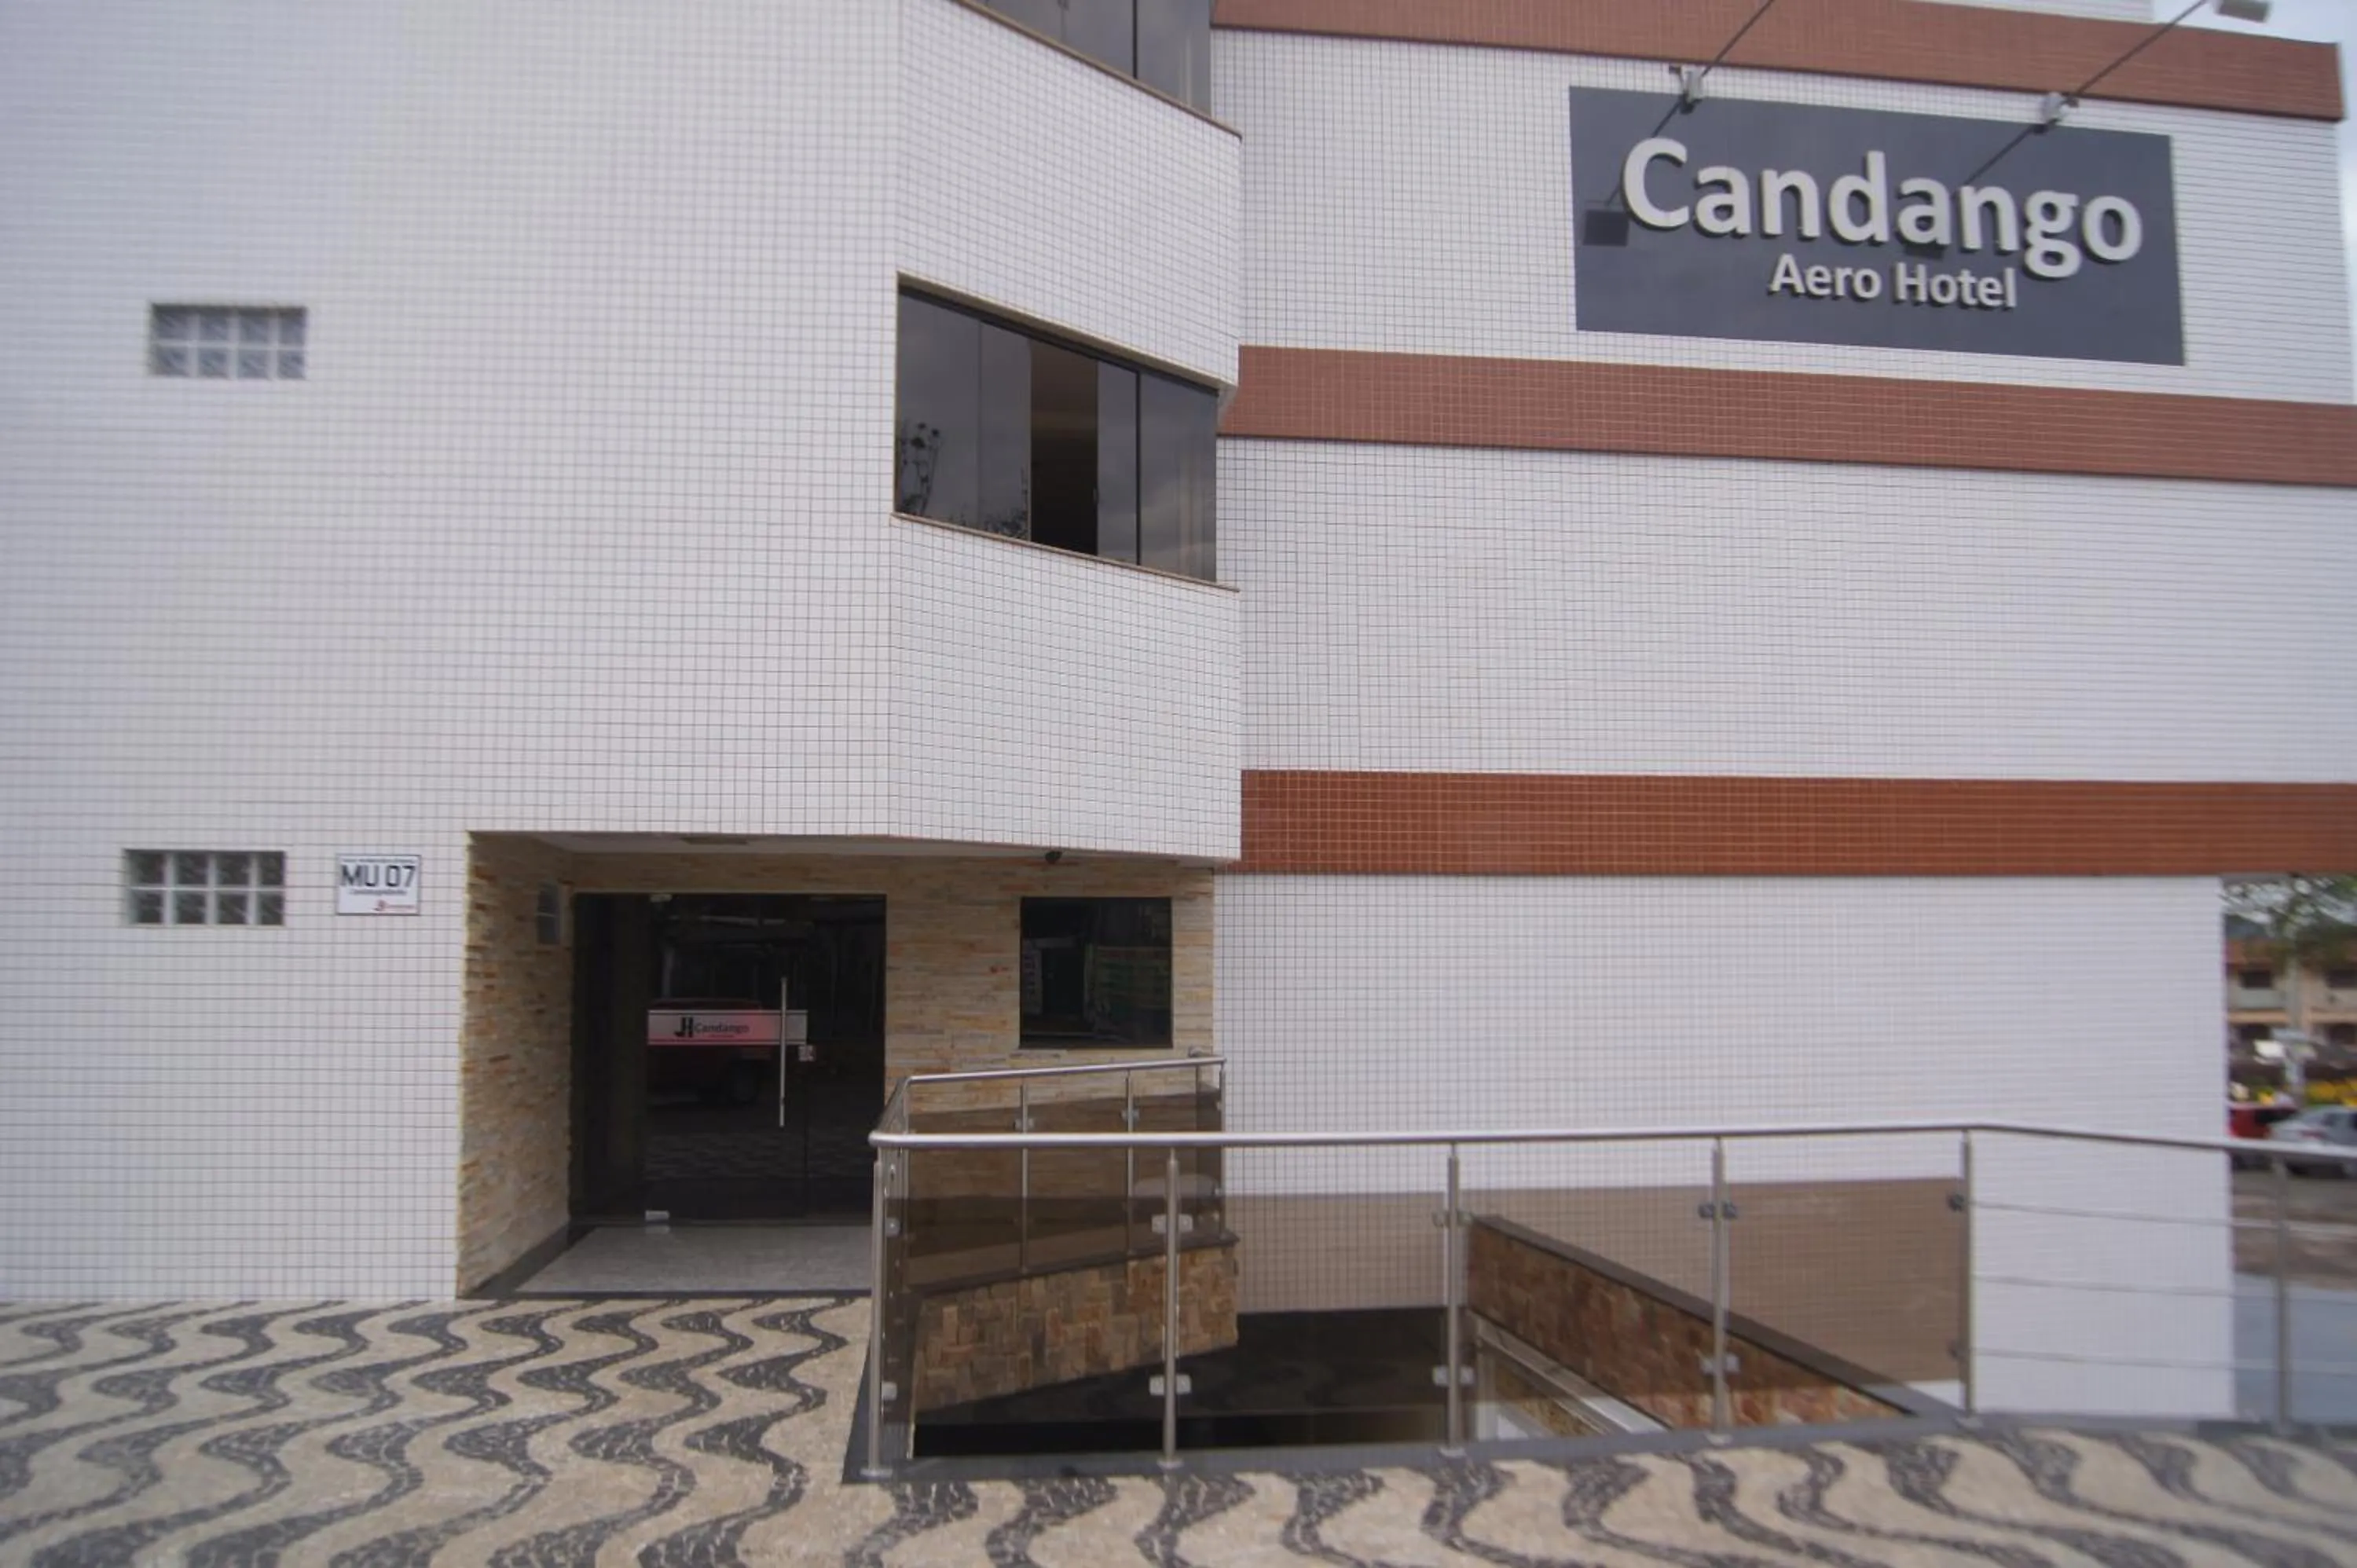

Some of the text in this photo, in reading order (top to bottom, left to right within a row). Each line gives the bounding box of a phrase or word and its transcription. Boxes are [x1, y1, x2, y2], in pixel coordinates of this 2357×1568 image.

[1622, 137, 2143, 278] Candango
[1769, 253, 2018, 309] Aero Hotel
[340, 864, 416, 887] MU 07
[695, 1022, 750, 1034] Candango
